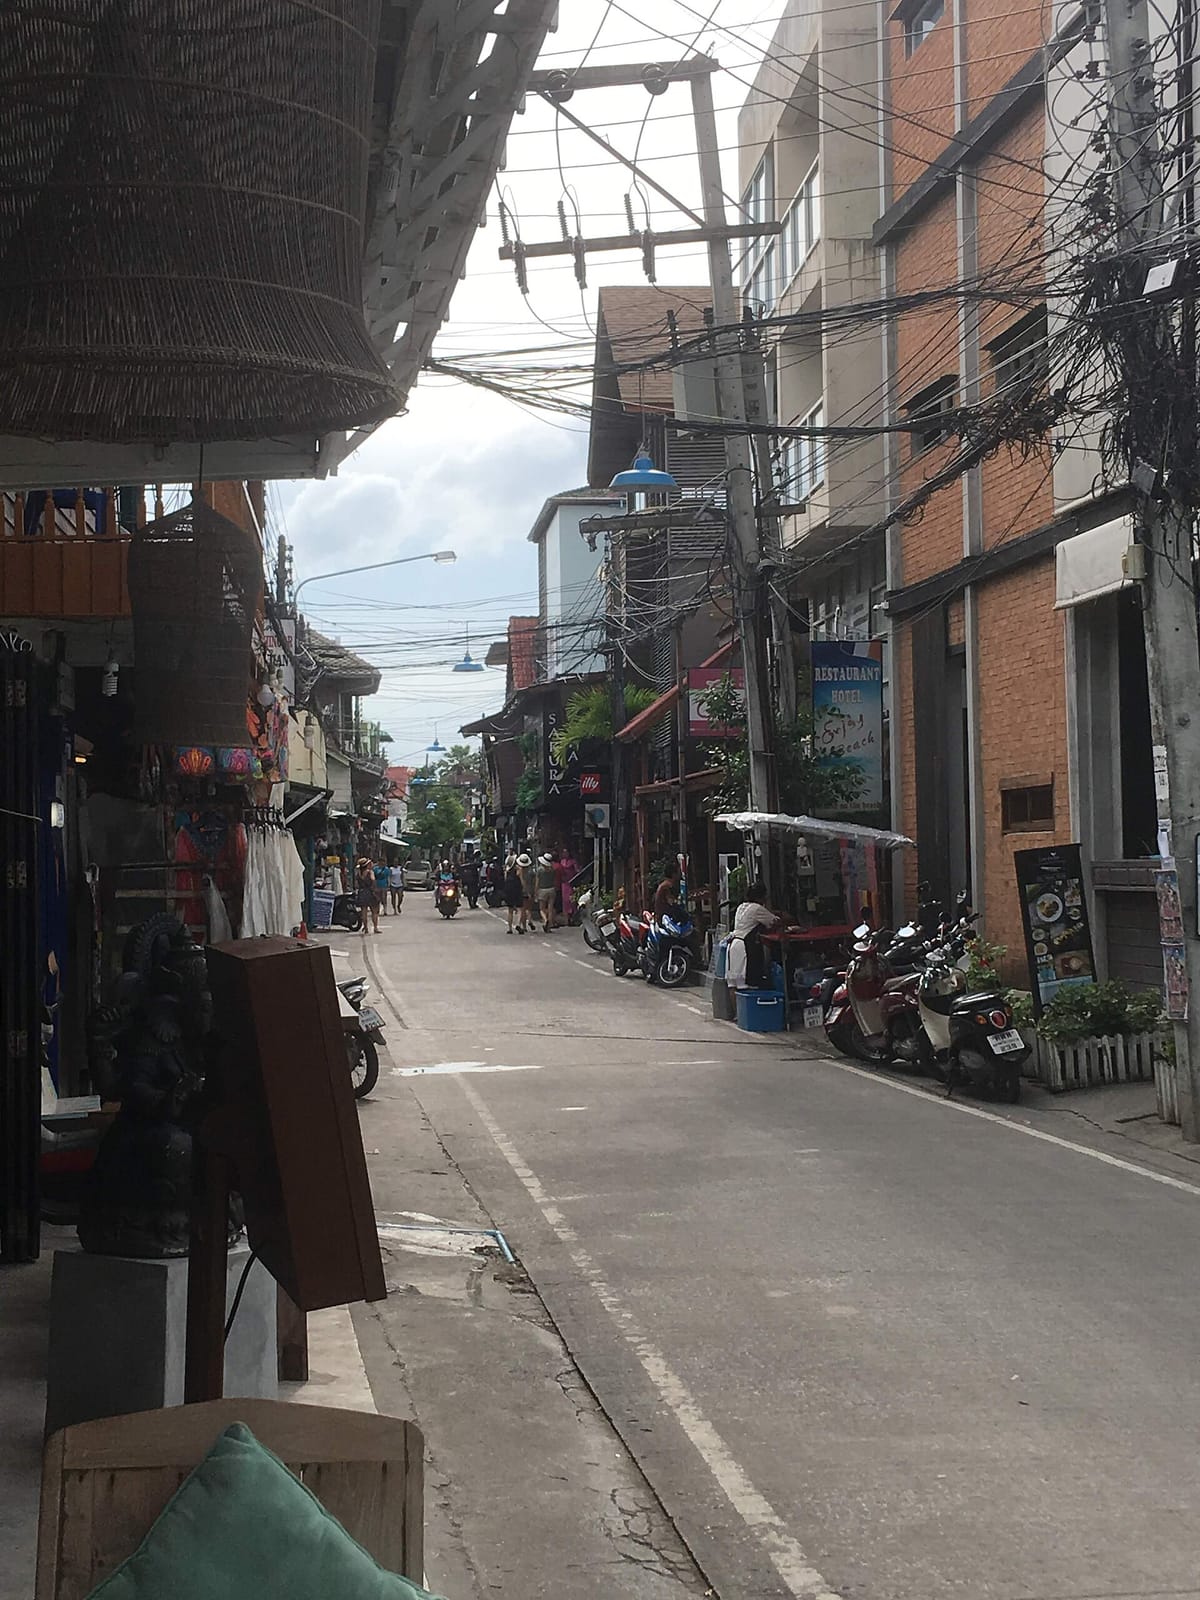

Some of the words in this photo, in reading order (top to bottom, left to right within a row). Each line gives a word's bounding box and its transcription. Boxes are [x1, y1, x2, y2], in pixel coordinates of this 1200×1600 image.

[814, 667, 881, 682] RESTAURANT
[831, 690, 864, 704] HOTEL
[582, 776, 599, 791] illy
